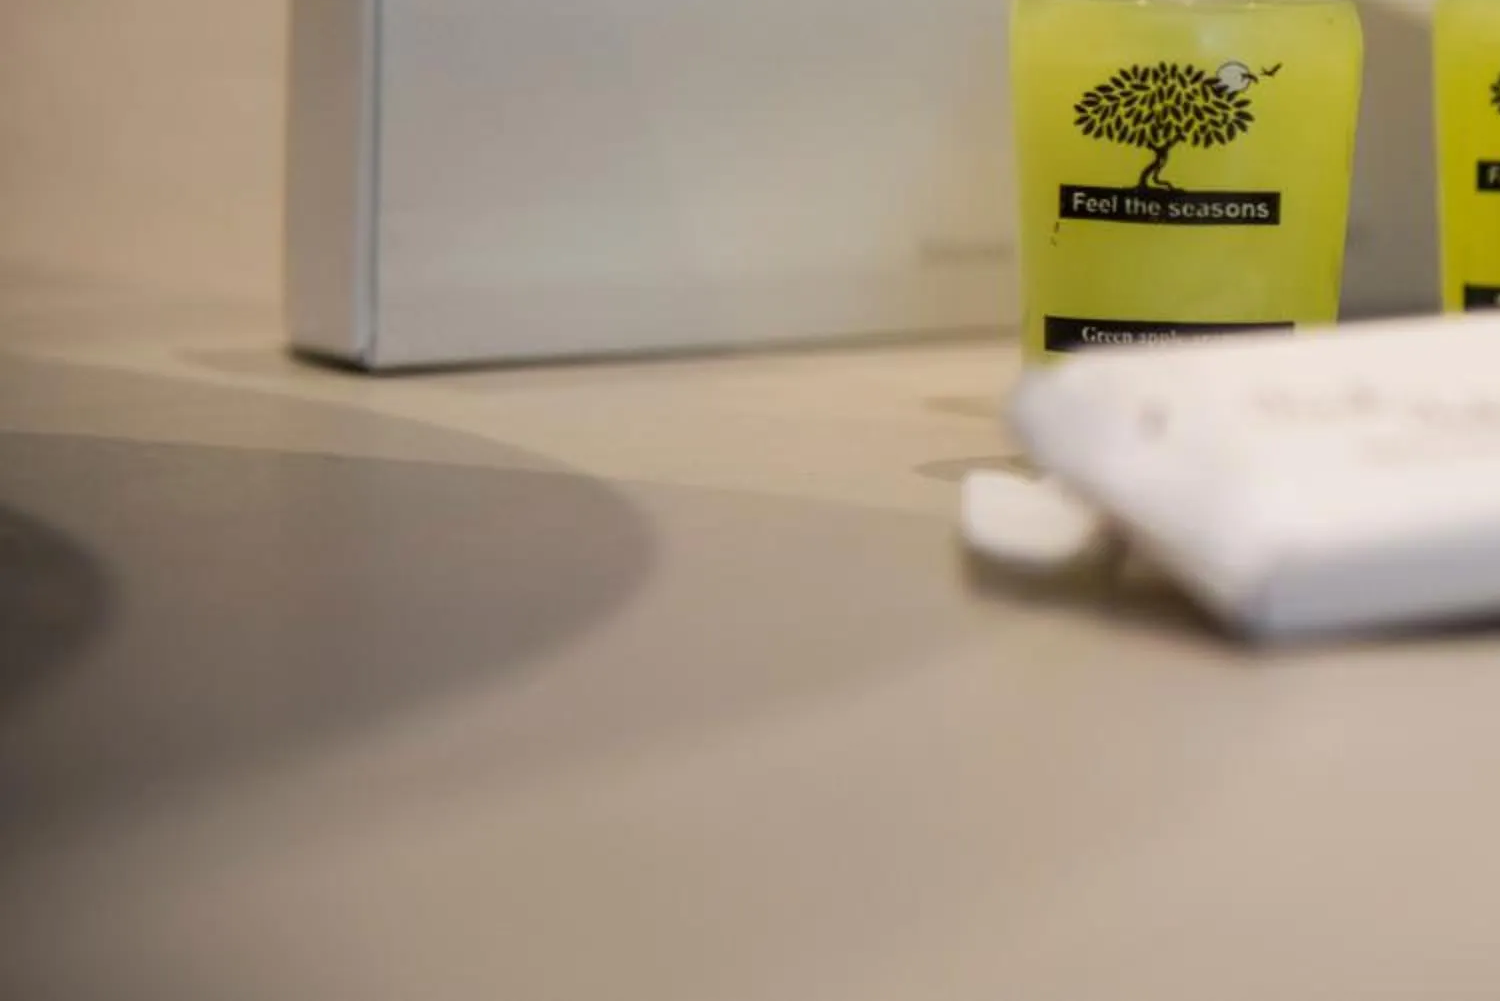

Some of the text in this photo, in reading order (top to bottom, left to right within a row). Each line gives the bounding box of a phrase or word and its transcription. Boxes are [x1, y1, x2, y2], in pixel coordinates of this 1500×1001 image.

[1072, 192, 1270, 219] Feel the seasons
[1081, 326, 1134, 343] Green
